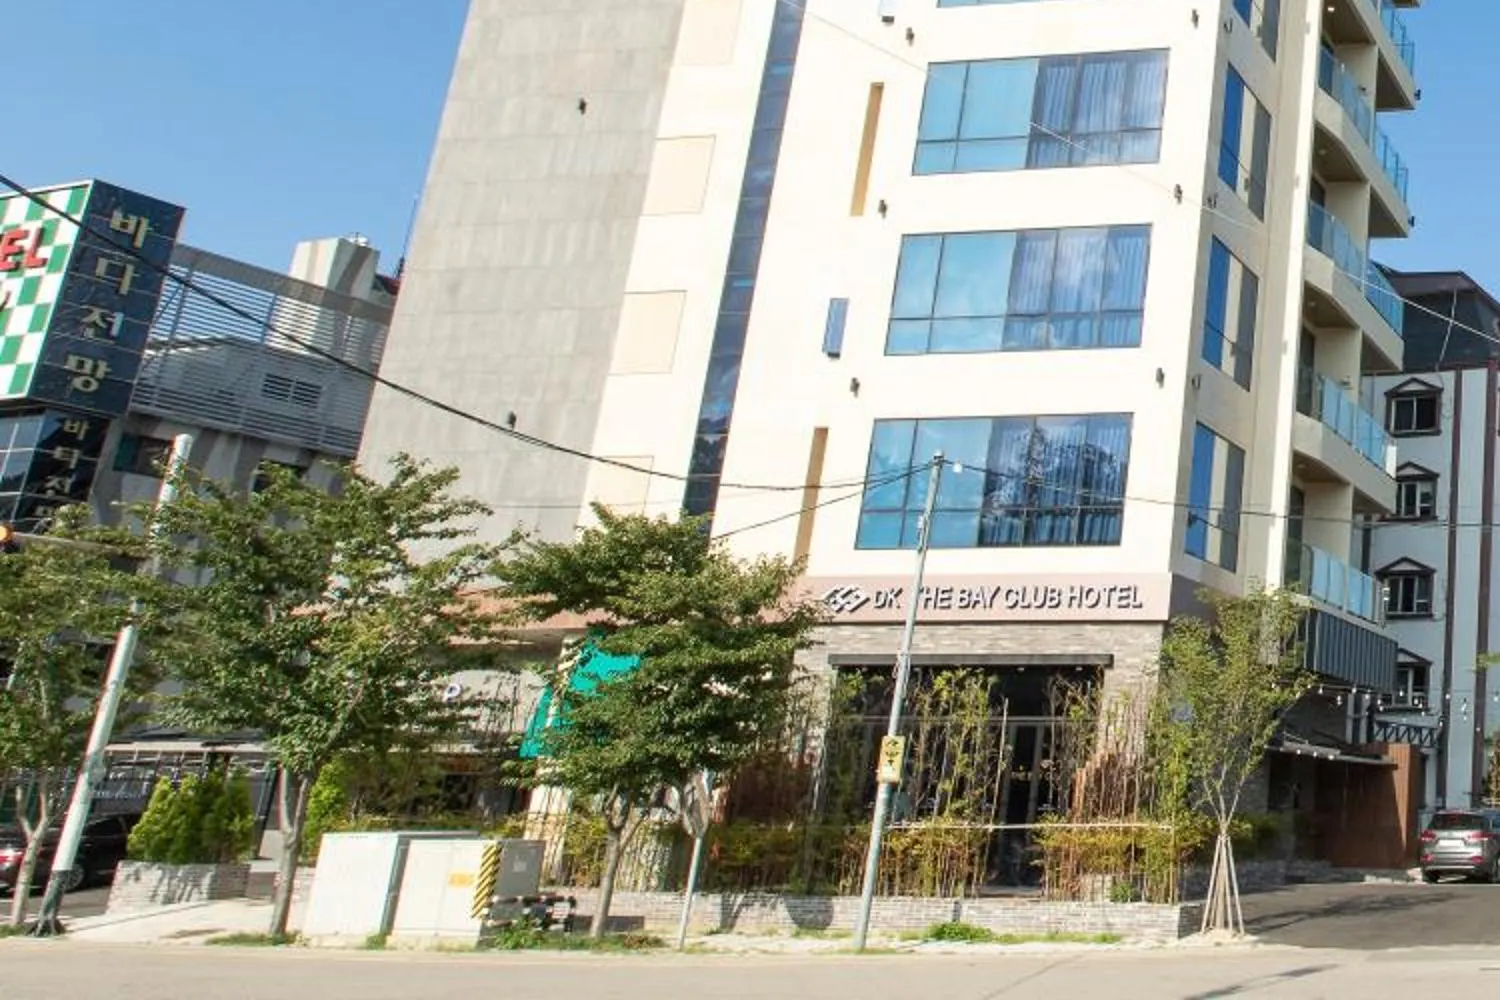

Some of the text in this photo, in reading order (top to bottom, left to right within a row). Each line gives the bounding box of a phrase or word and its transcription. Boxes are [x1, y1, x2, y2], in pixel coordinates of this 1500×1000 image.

[873, 584, 1144, 610] DK HE BAY CLUB HOTEL
